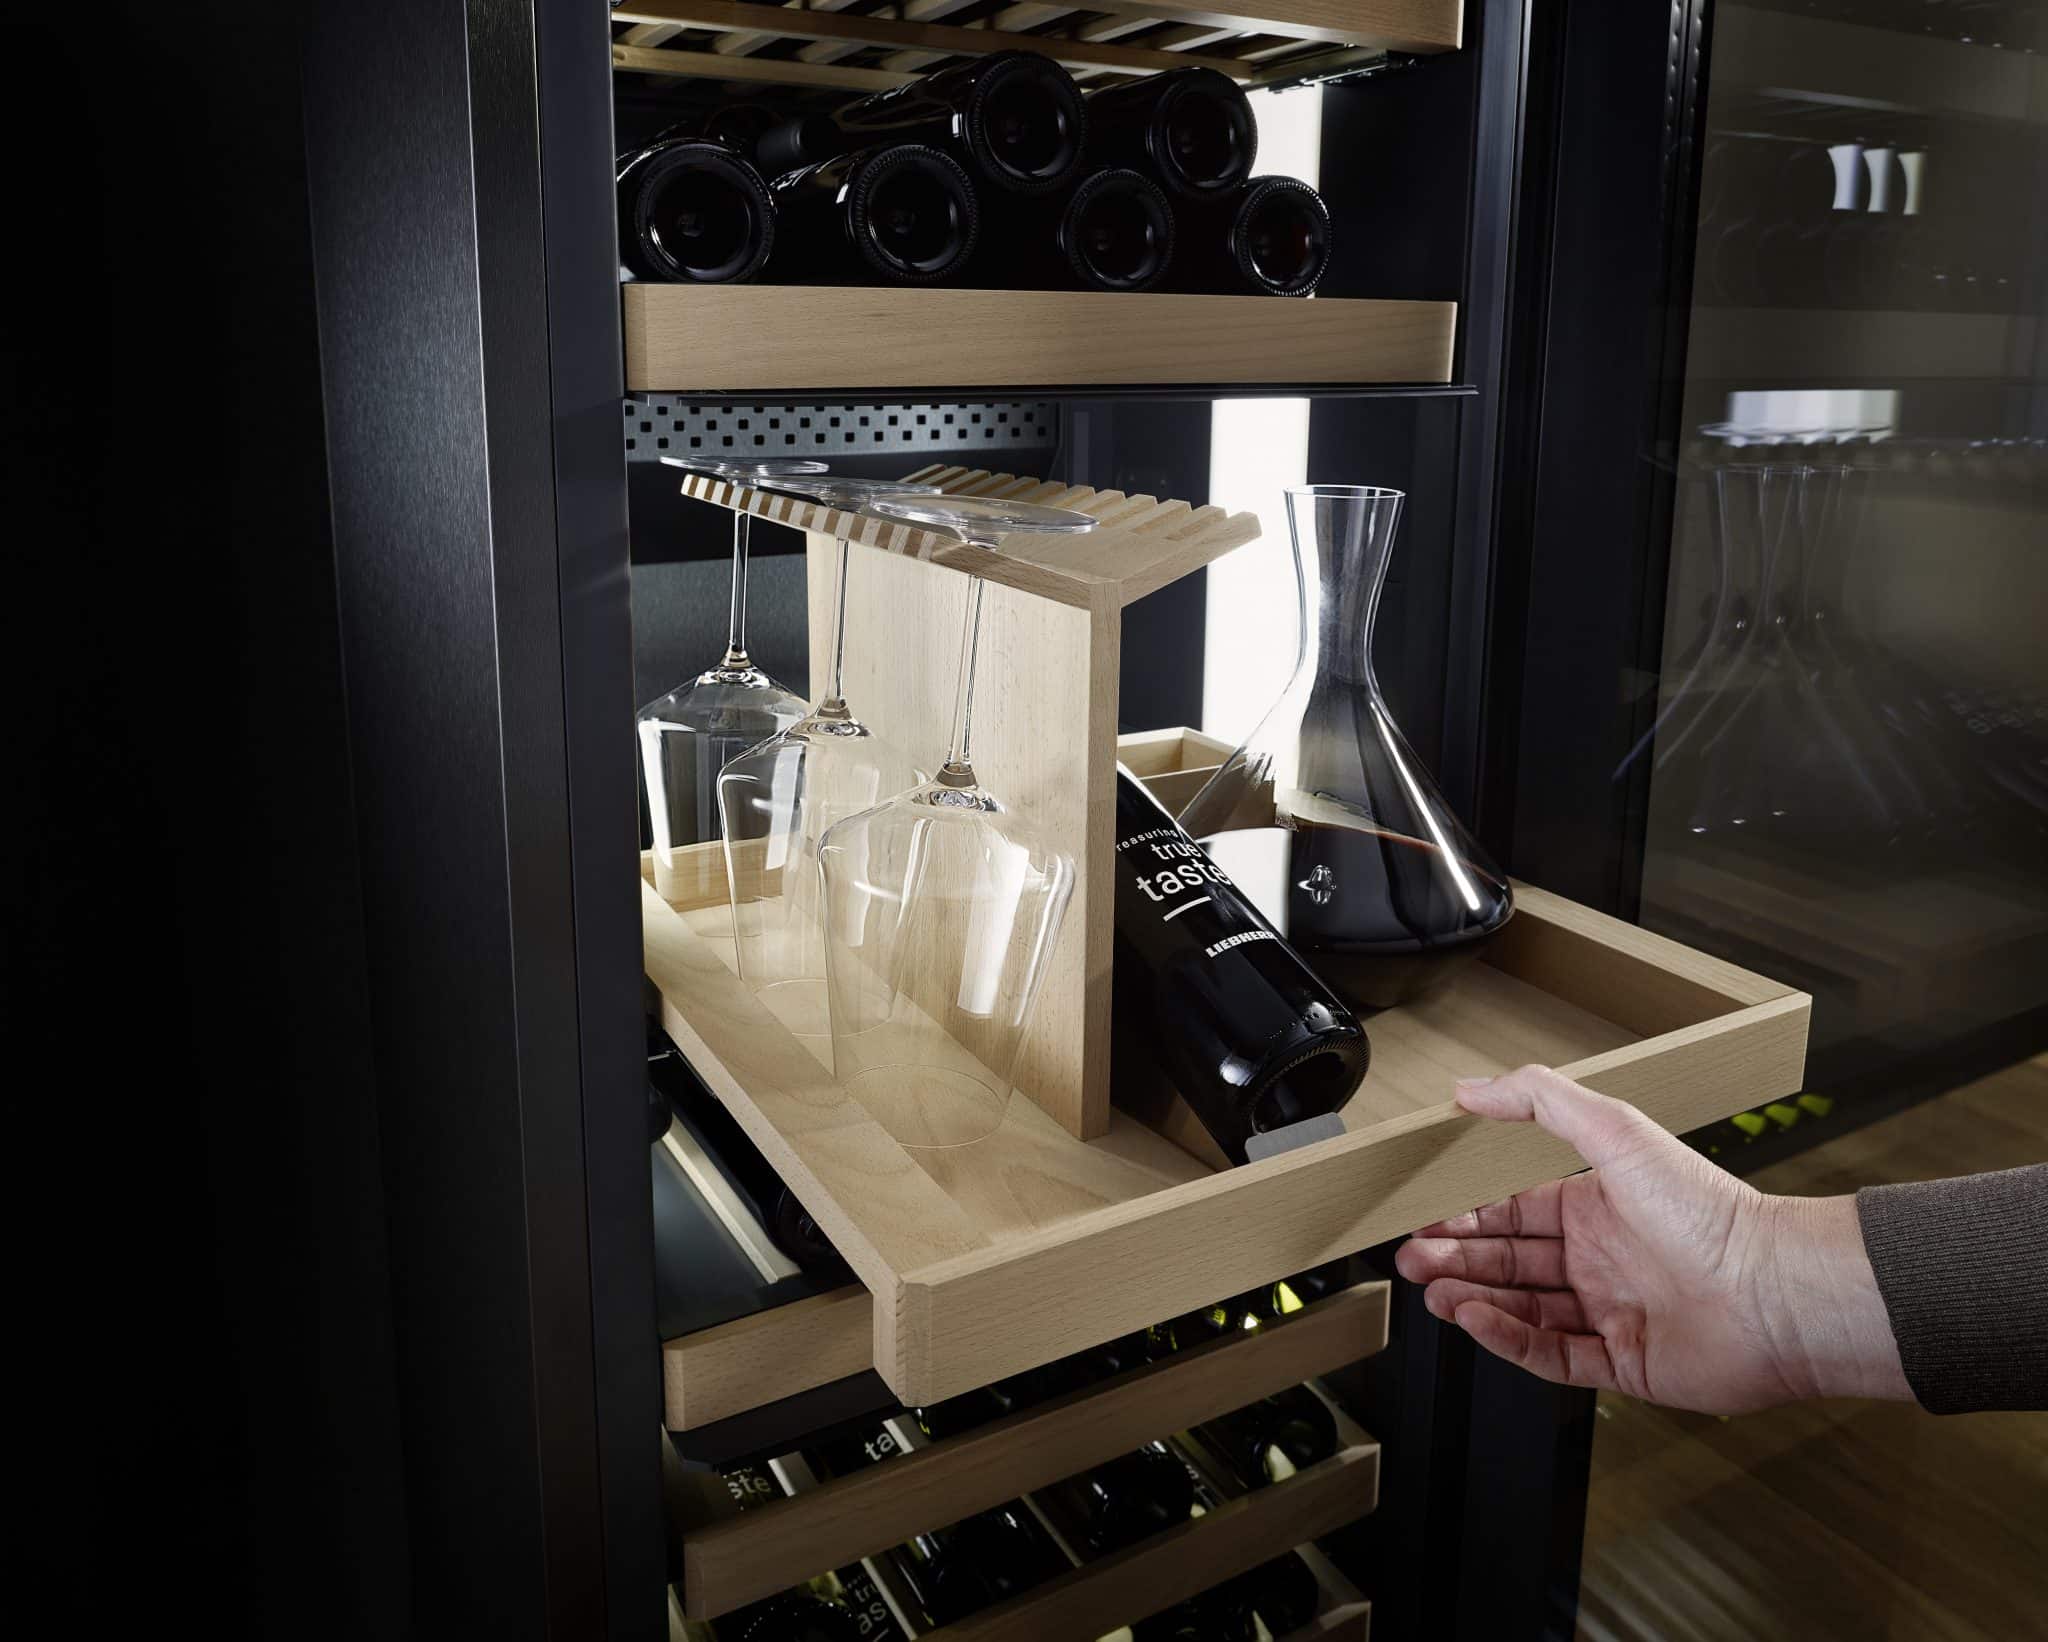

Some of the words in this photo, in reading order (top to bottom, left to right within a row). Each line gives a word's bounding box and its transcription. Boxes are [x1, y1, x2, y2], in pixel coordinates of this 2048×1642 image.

[1116, 827, 1179, 852] reasuring
[1150, 842, 1202, 860] true
[1135, 858, 1232, 902] taste
